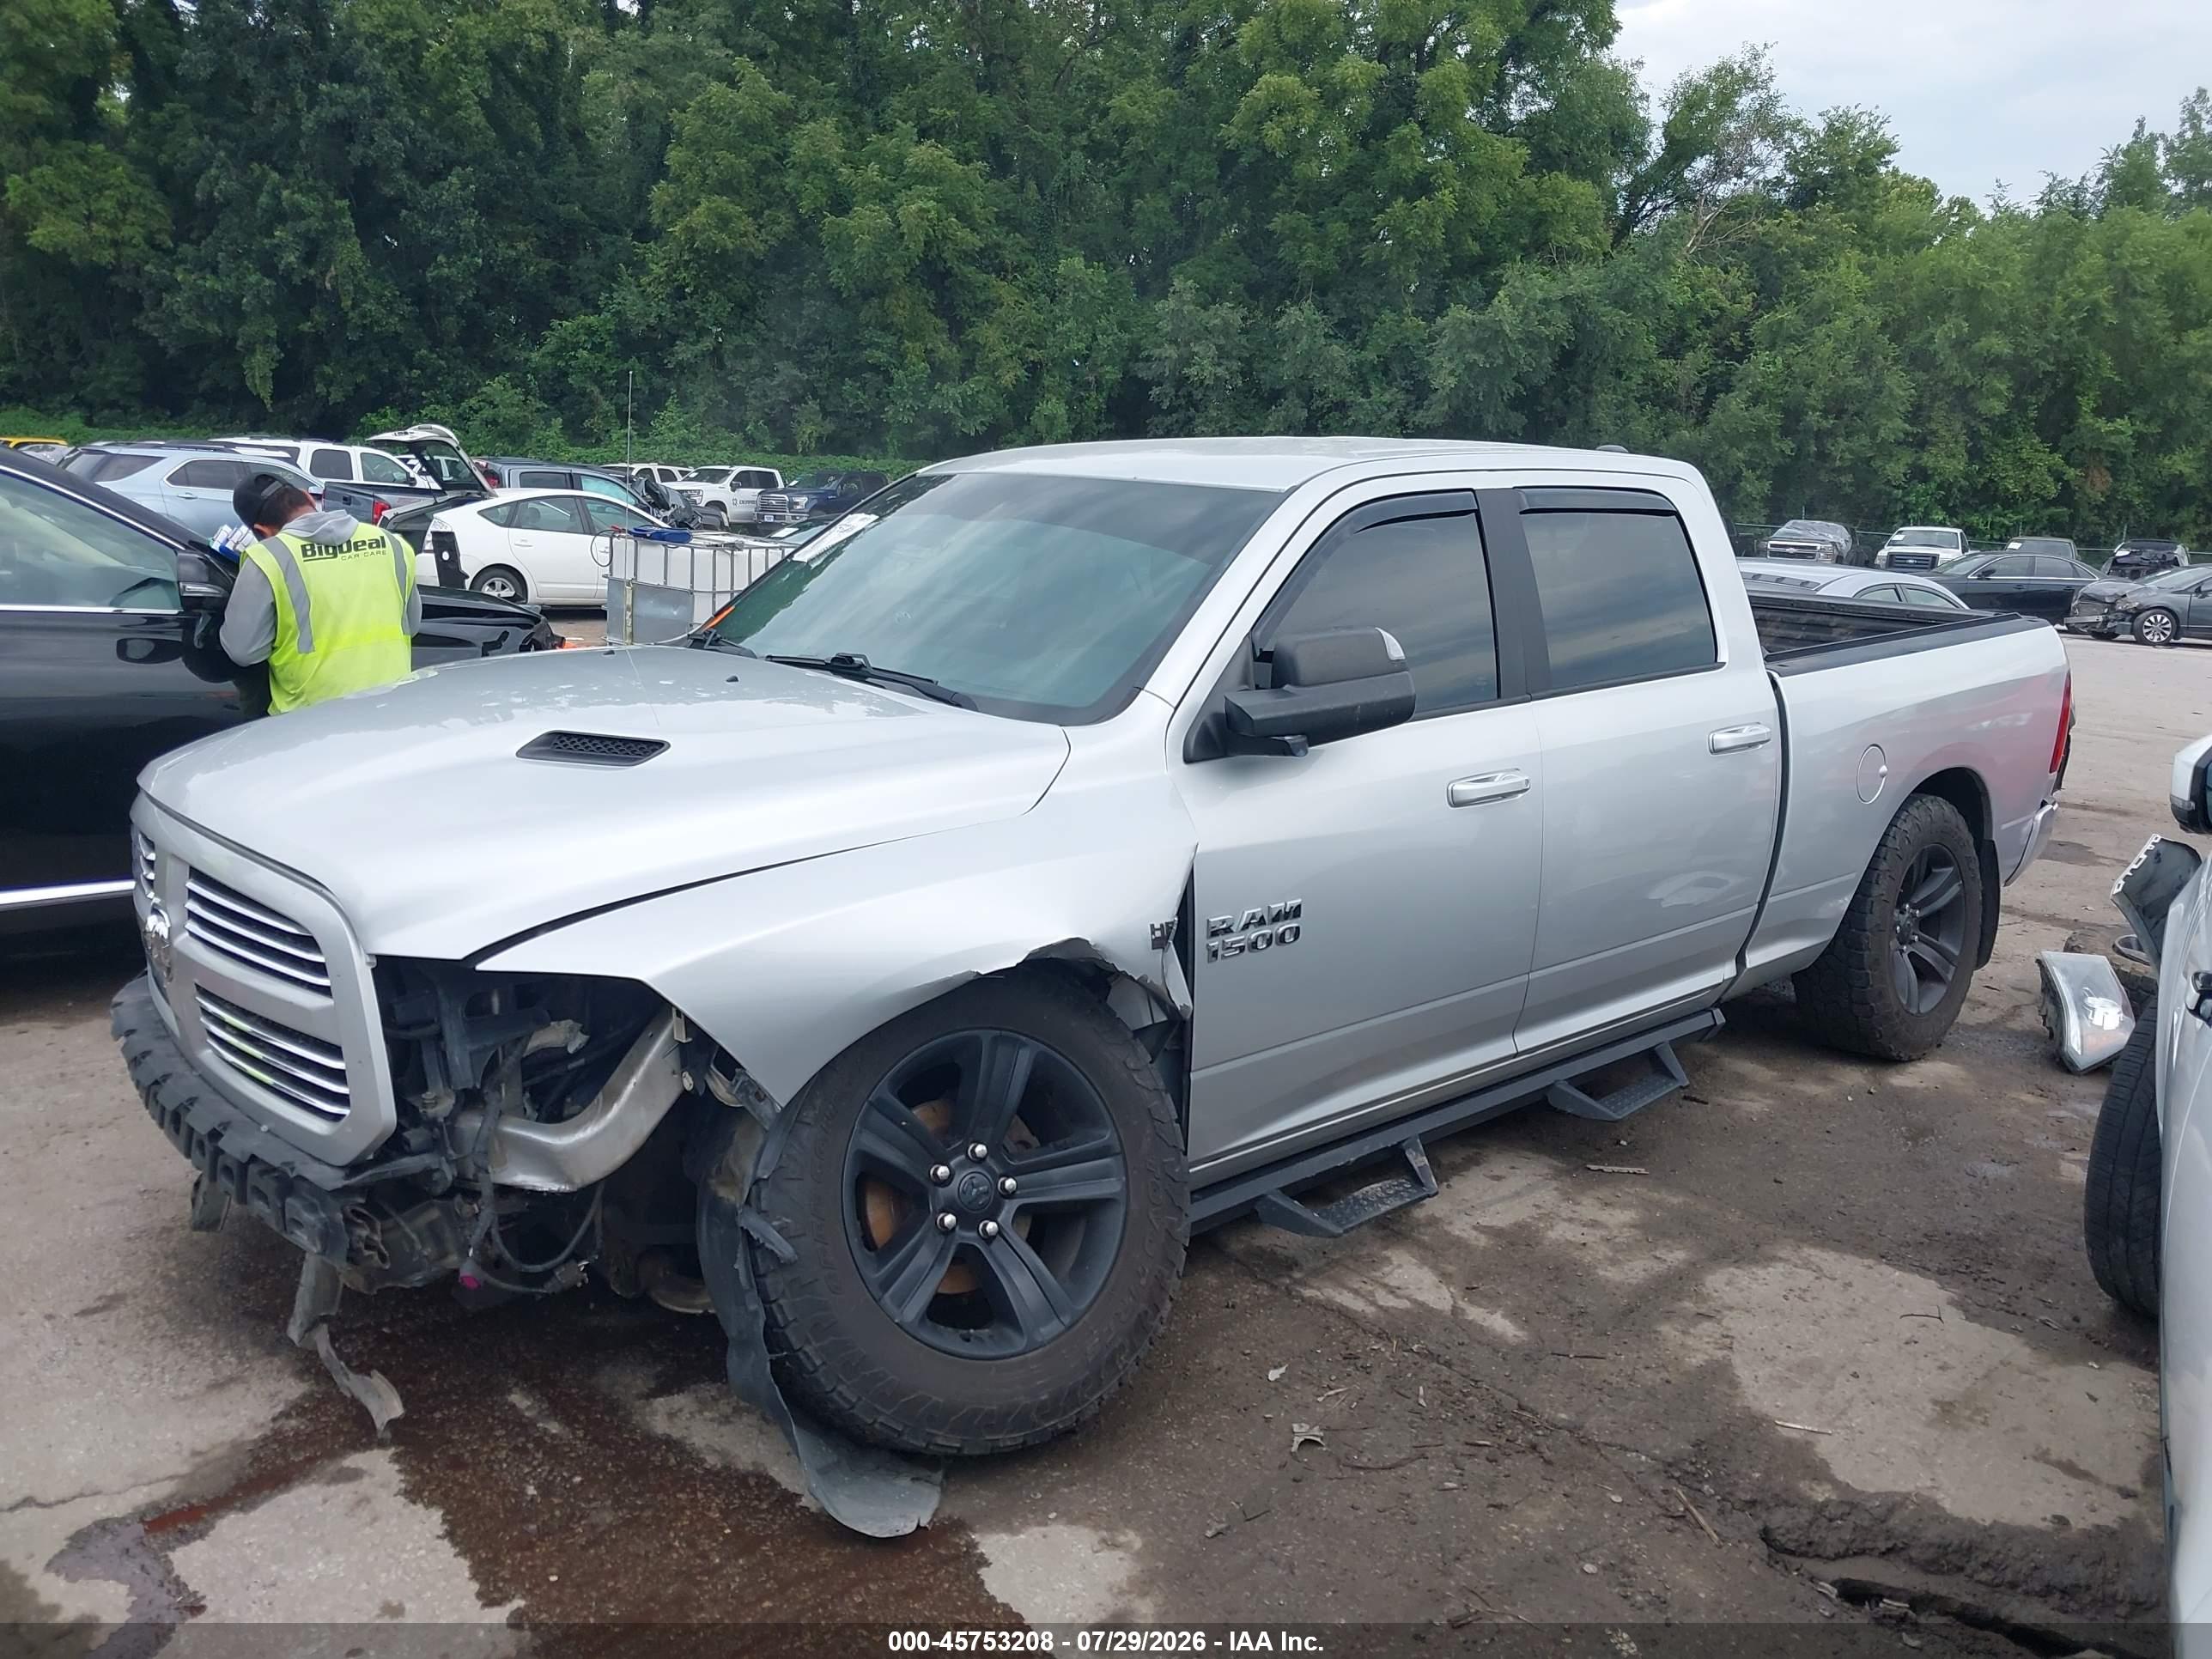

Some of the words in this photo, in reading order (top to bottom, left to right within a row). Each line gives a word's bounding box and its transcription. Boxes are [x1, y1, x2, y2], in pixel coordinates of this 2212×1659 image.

[301, 536, 386, 561] BigDeal
[1206, 898, 1302, 939] RAM
[1206, 923, 1301, 963] 1500
